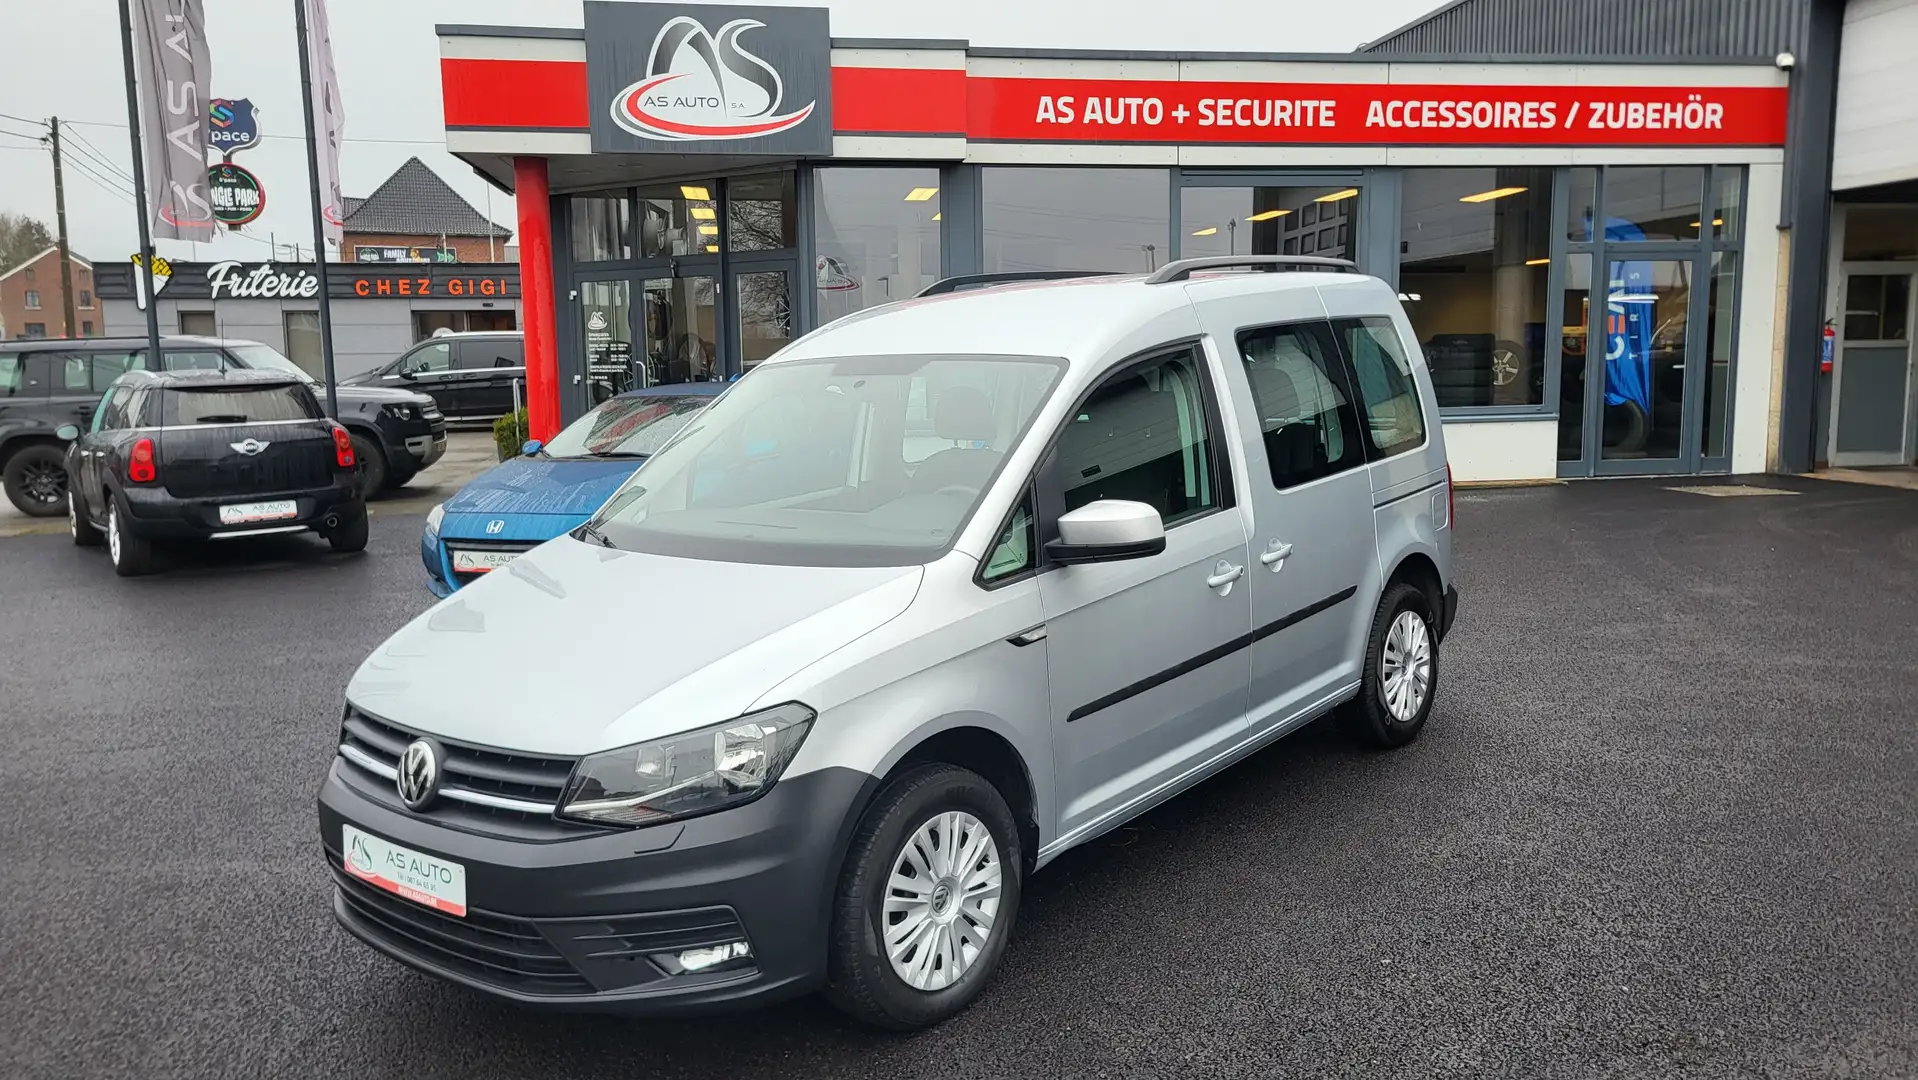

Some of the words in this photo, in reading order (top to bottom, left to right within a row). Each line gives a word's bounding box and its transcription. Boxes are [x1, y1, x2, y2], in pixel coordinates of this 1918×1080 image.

[644, 96, 669, 108] AS
[673, 96, 720, 109] AUTO
[1035, 96, 1075, 124] AS
[1083, 96, 1164, 125] AUTO
[1197, 98, 1337, 128] SECURITE
[1364, 100, 1557, 129] ACCESSOIRES
[1588, 93, 1724, 130] ZUBEHÖR
[210, 186, 234, 207] NGLE
[234, 187, 260, 207] PARK
[383, 248, 407, 259] FAMILY
[206, 260, 320, 299] Friterie
[354, 279, 431, 296] CHEZ
[448, 279, 507, 296] GIGI
[1629, 271, 1640, 360] TIRS
[483, 555, 497, 563] AS
[497, 555, 520, 563] AUT
[386, 849, 406, 869] AS
[410, 858, 453, 884] AUTO
